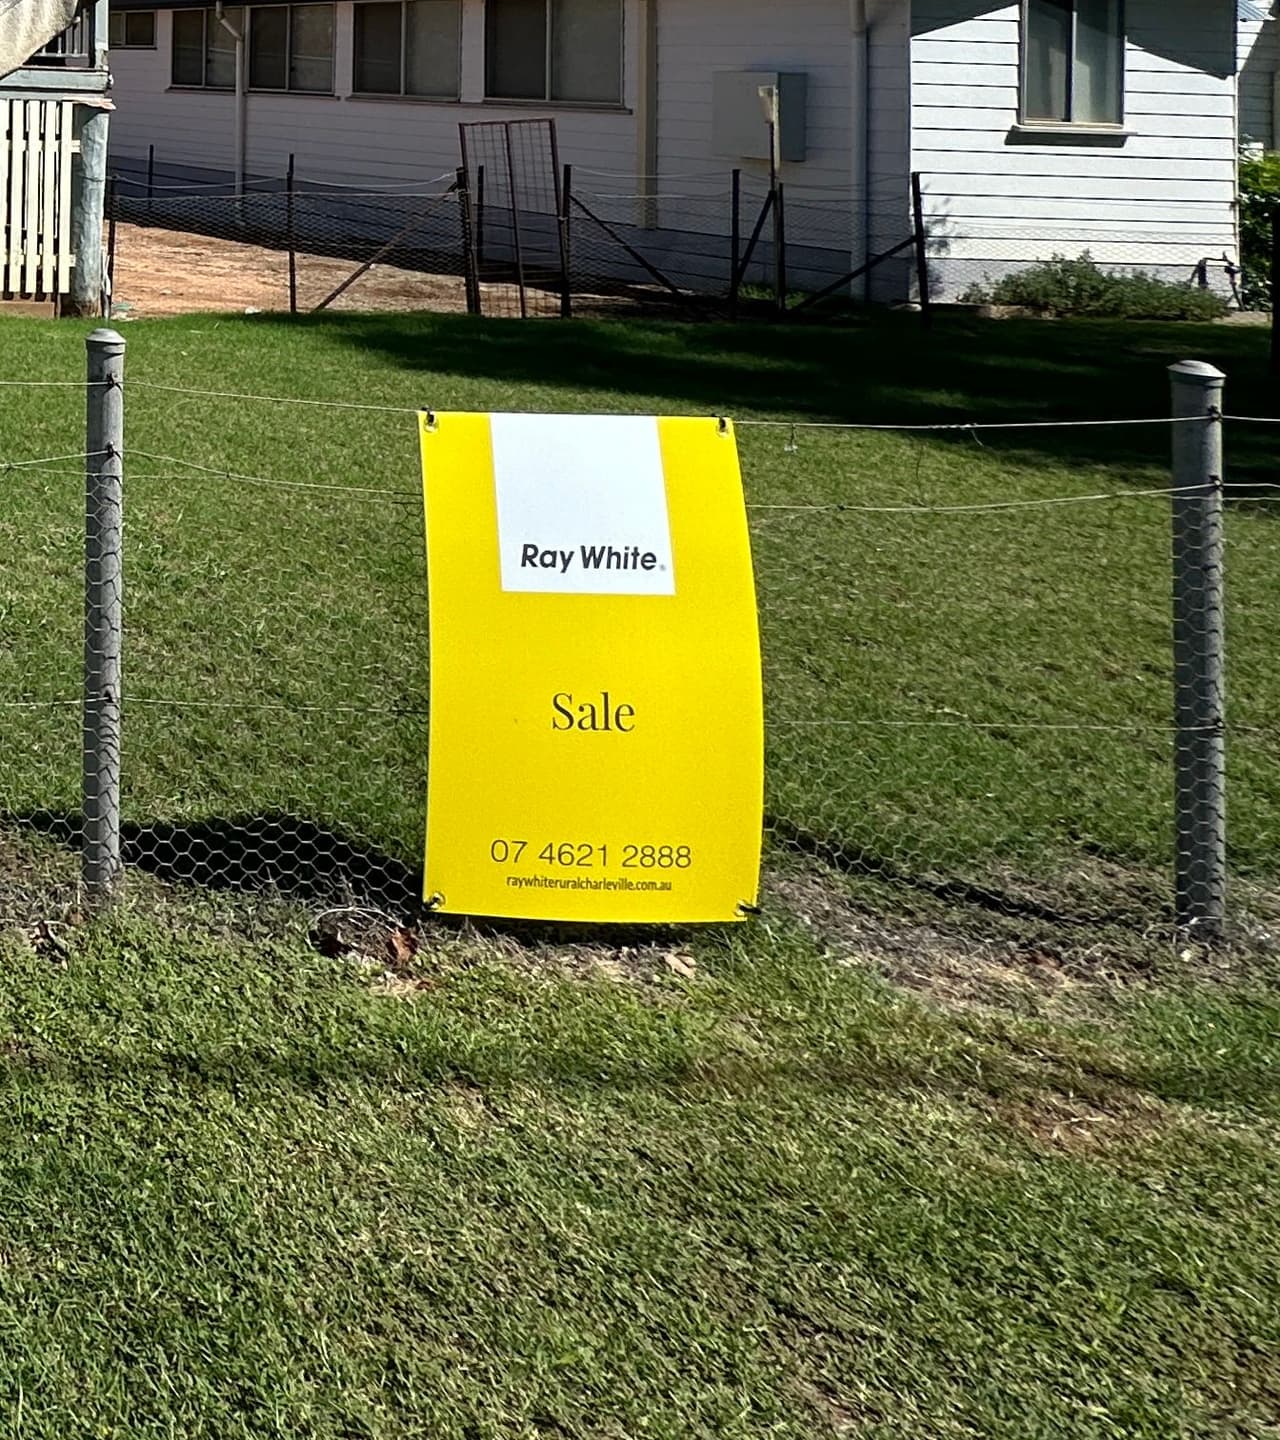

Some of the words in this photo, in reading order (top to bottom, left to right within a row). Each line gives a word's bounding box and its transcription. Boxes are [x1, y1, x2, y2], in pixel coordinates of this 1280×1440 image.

[521, 543, 575, 573] Ray
[551, 691, 635, 732] Sale
[491, 839, 528, 863] 07
[538, 842, 608, 867] 4621
[622, 845, 692, 868] 2888
[507, 874, 672, 891] raywhiteruralcharleville.com.au
